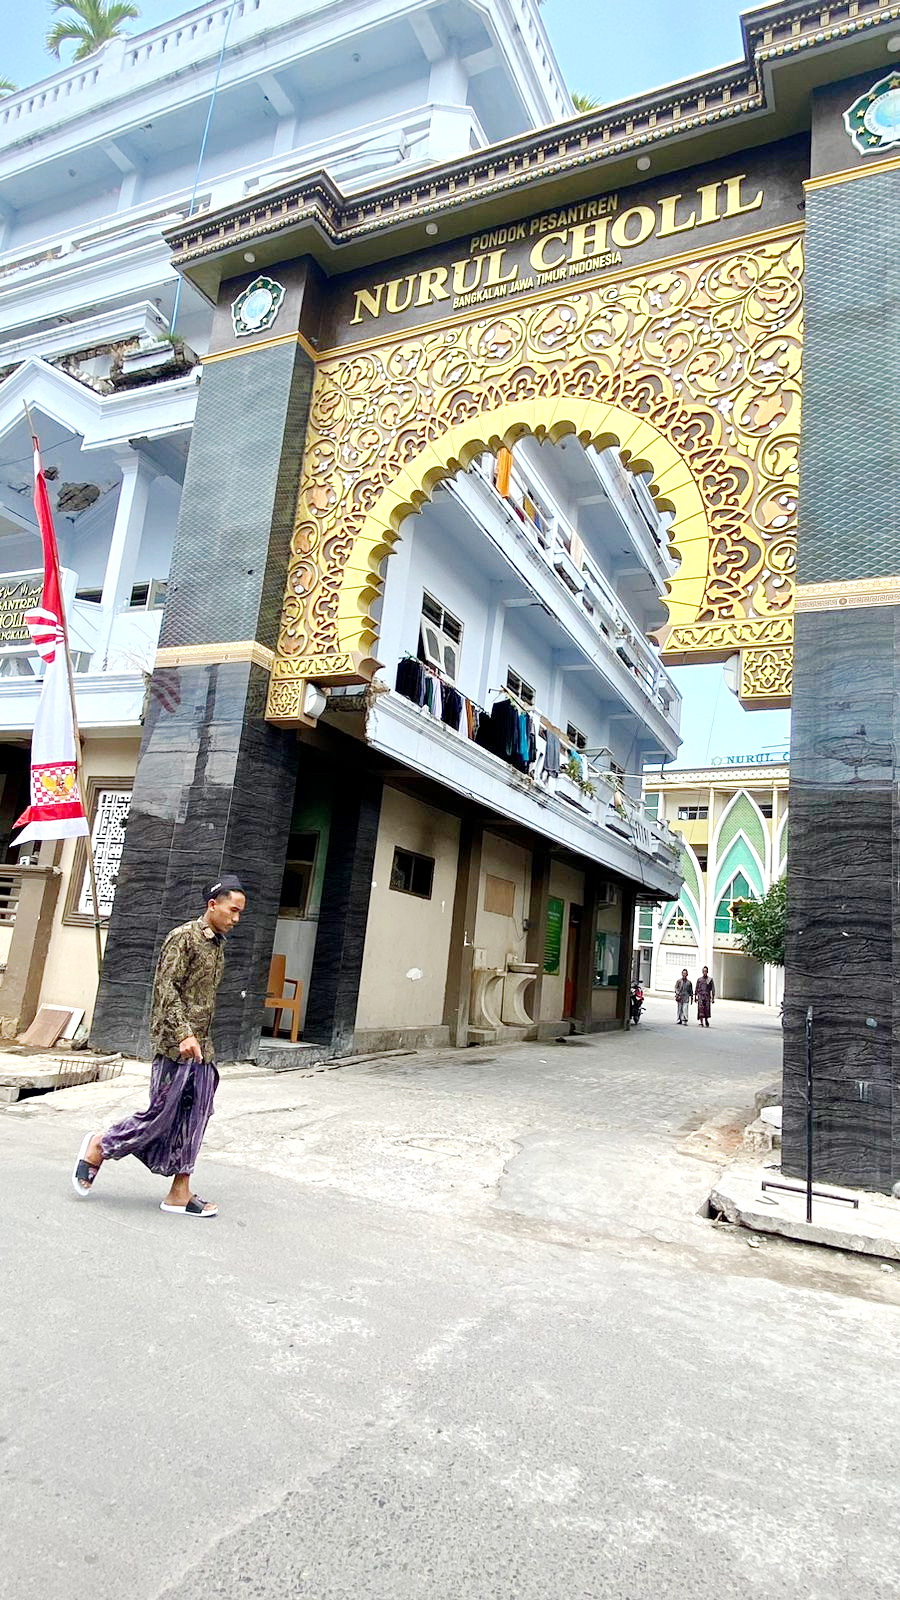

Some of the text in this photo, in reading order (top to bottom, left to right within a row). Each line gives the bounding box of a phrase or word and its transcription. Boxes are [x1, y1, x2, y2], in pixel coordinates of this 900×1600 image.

[349, 174, 764, 325] NURUL CHOLIL
[470, 194, 619, 253] PONDOK PESANTREN
[452, 251, 623, 310] BANGKALAN JAWA TIMUR INDONESIA
[727, 753, 773, 764] NURUL
